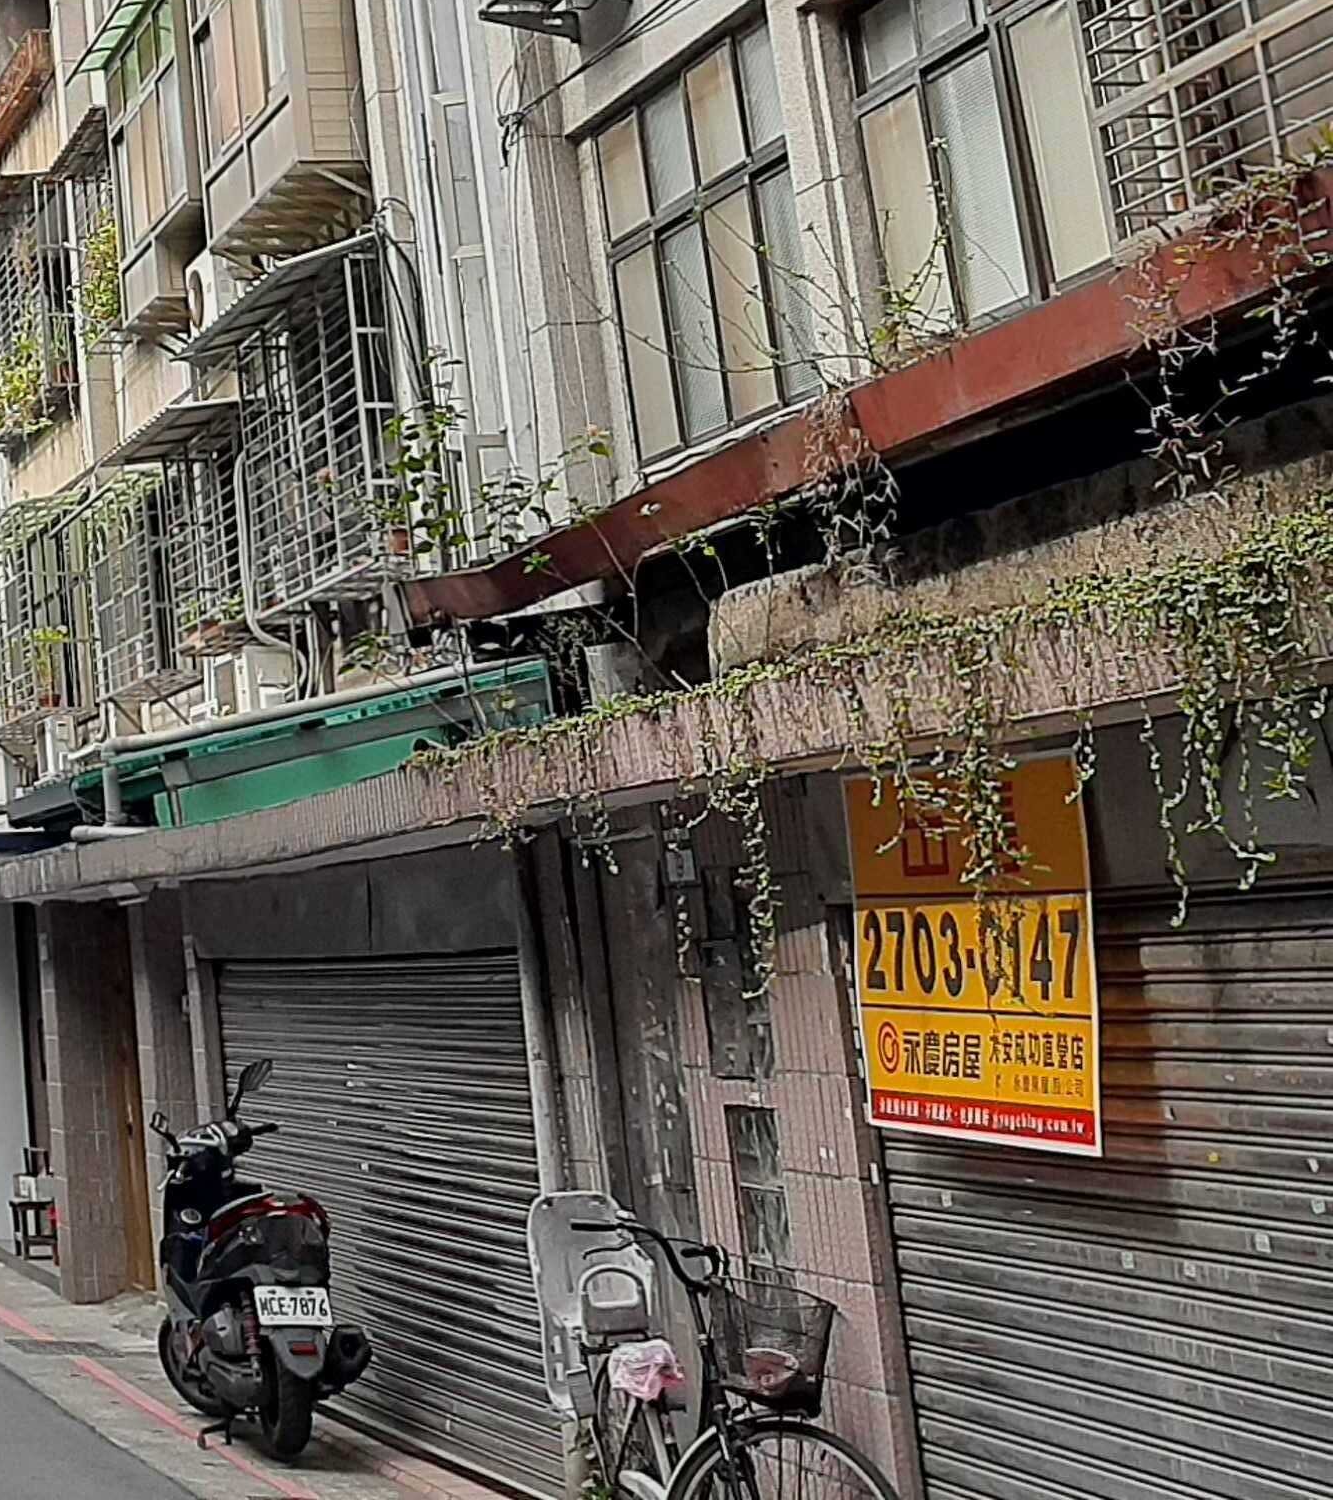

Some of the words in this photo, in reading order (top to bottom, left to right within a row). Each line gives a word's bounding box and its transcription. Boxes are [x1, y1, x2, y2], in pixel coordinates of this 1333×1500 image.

[862, 908, 1080, 1002] 2703-0147
[902, 1029, 981, 1080] 永慶房屋
